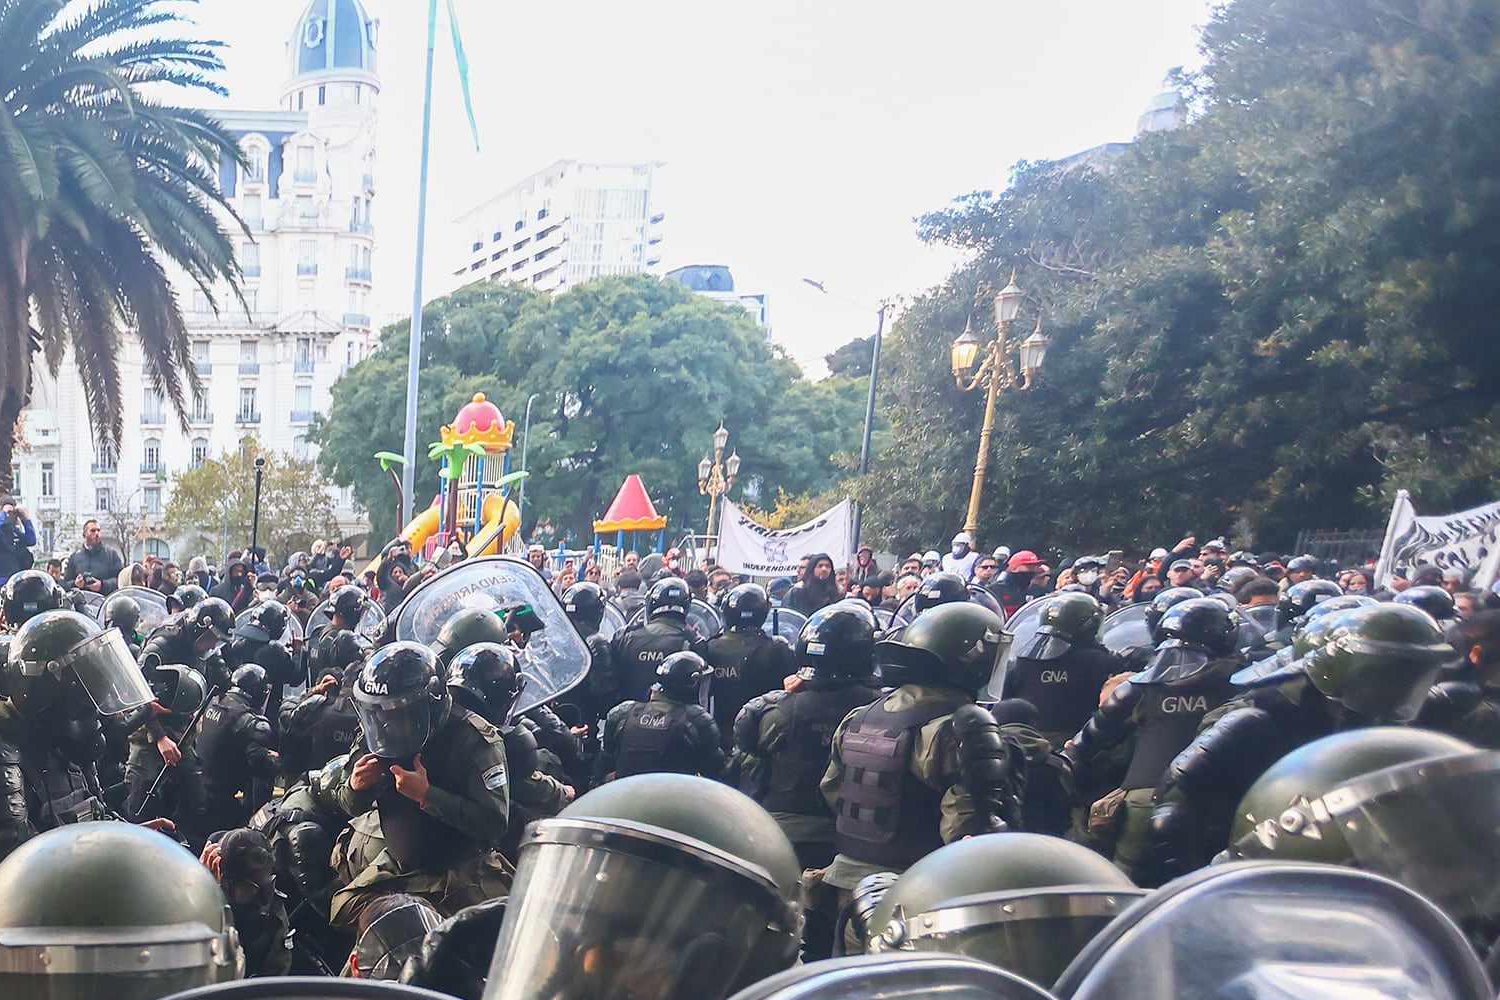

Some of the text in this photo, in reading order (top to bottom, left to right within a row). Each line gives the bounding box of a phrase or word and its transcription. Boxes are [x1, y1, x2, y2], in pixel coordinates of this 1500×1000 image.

[638, 651, 665, 661] GNA
[714, 667, 738, 678] GNA
[1040, 670, 1068, 683] GNA
[364, 682, 389, 695] GNA
[1162, 696, 1207, 713] GNA
[205, 708, 222, 722] GNA
[640, 714, 666, 727] GNA
